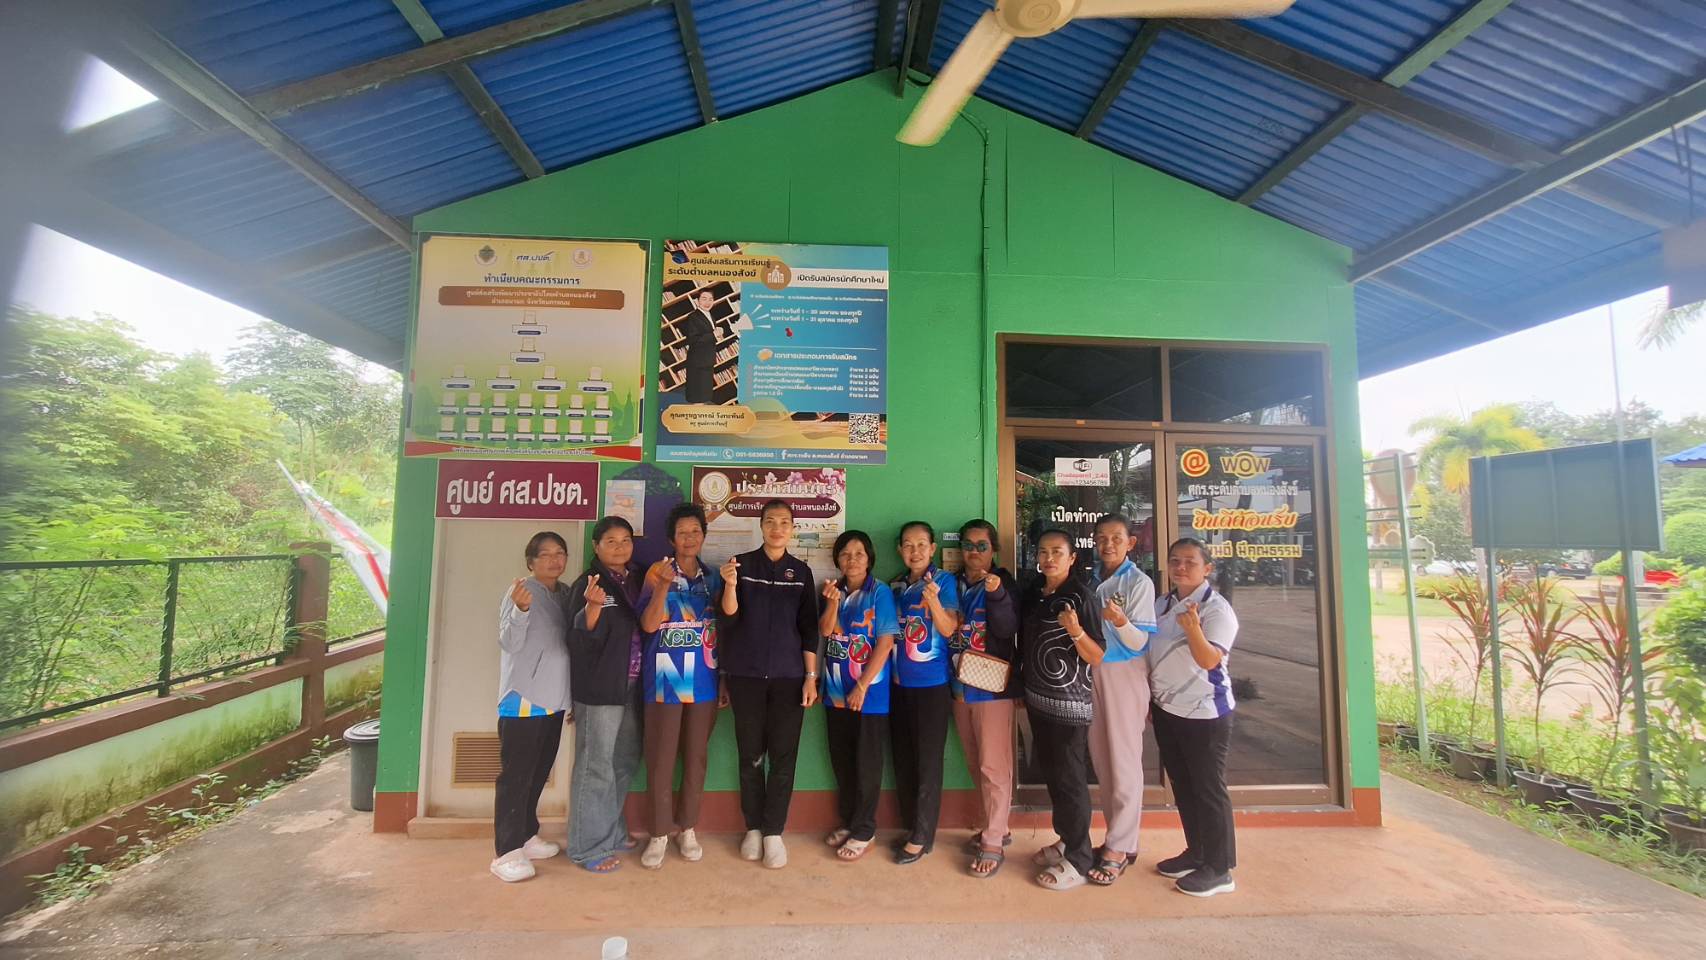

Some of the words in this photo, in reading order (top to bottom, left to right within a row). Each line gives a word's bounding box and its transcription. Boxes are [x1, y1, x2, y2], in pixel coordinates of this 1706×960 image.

[668, 267, 757, 278] ระดับตำบลหนองสังข์
[690, 257, 772, 269] ศูนย์ส่งเสริมการเรียนรู้
[484, 273, 580, 286] ทำเนียบคณะกรรมการ
[796, 274, 885, 284] เปิดรับสมัครนักศึกษาใหม่
[1220, 454, 1271, 476] WOW
[446, 470, 495, 515] ศูนย์
[499, 473, 589, 506] ศส.ปชต.
[1193, 505, 1298, 530] ยินดีต้อนรับ
[1236, 541, 1303, 562] มีคุณธรรม
[659, 628, 702, 648] NCDs
